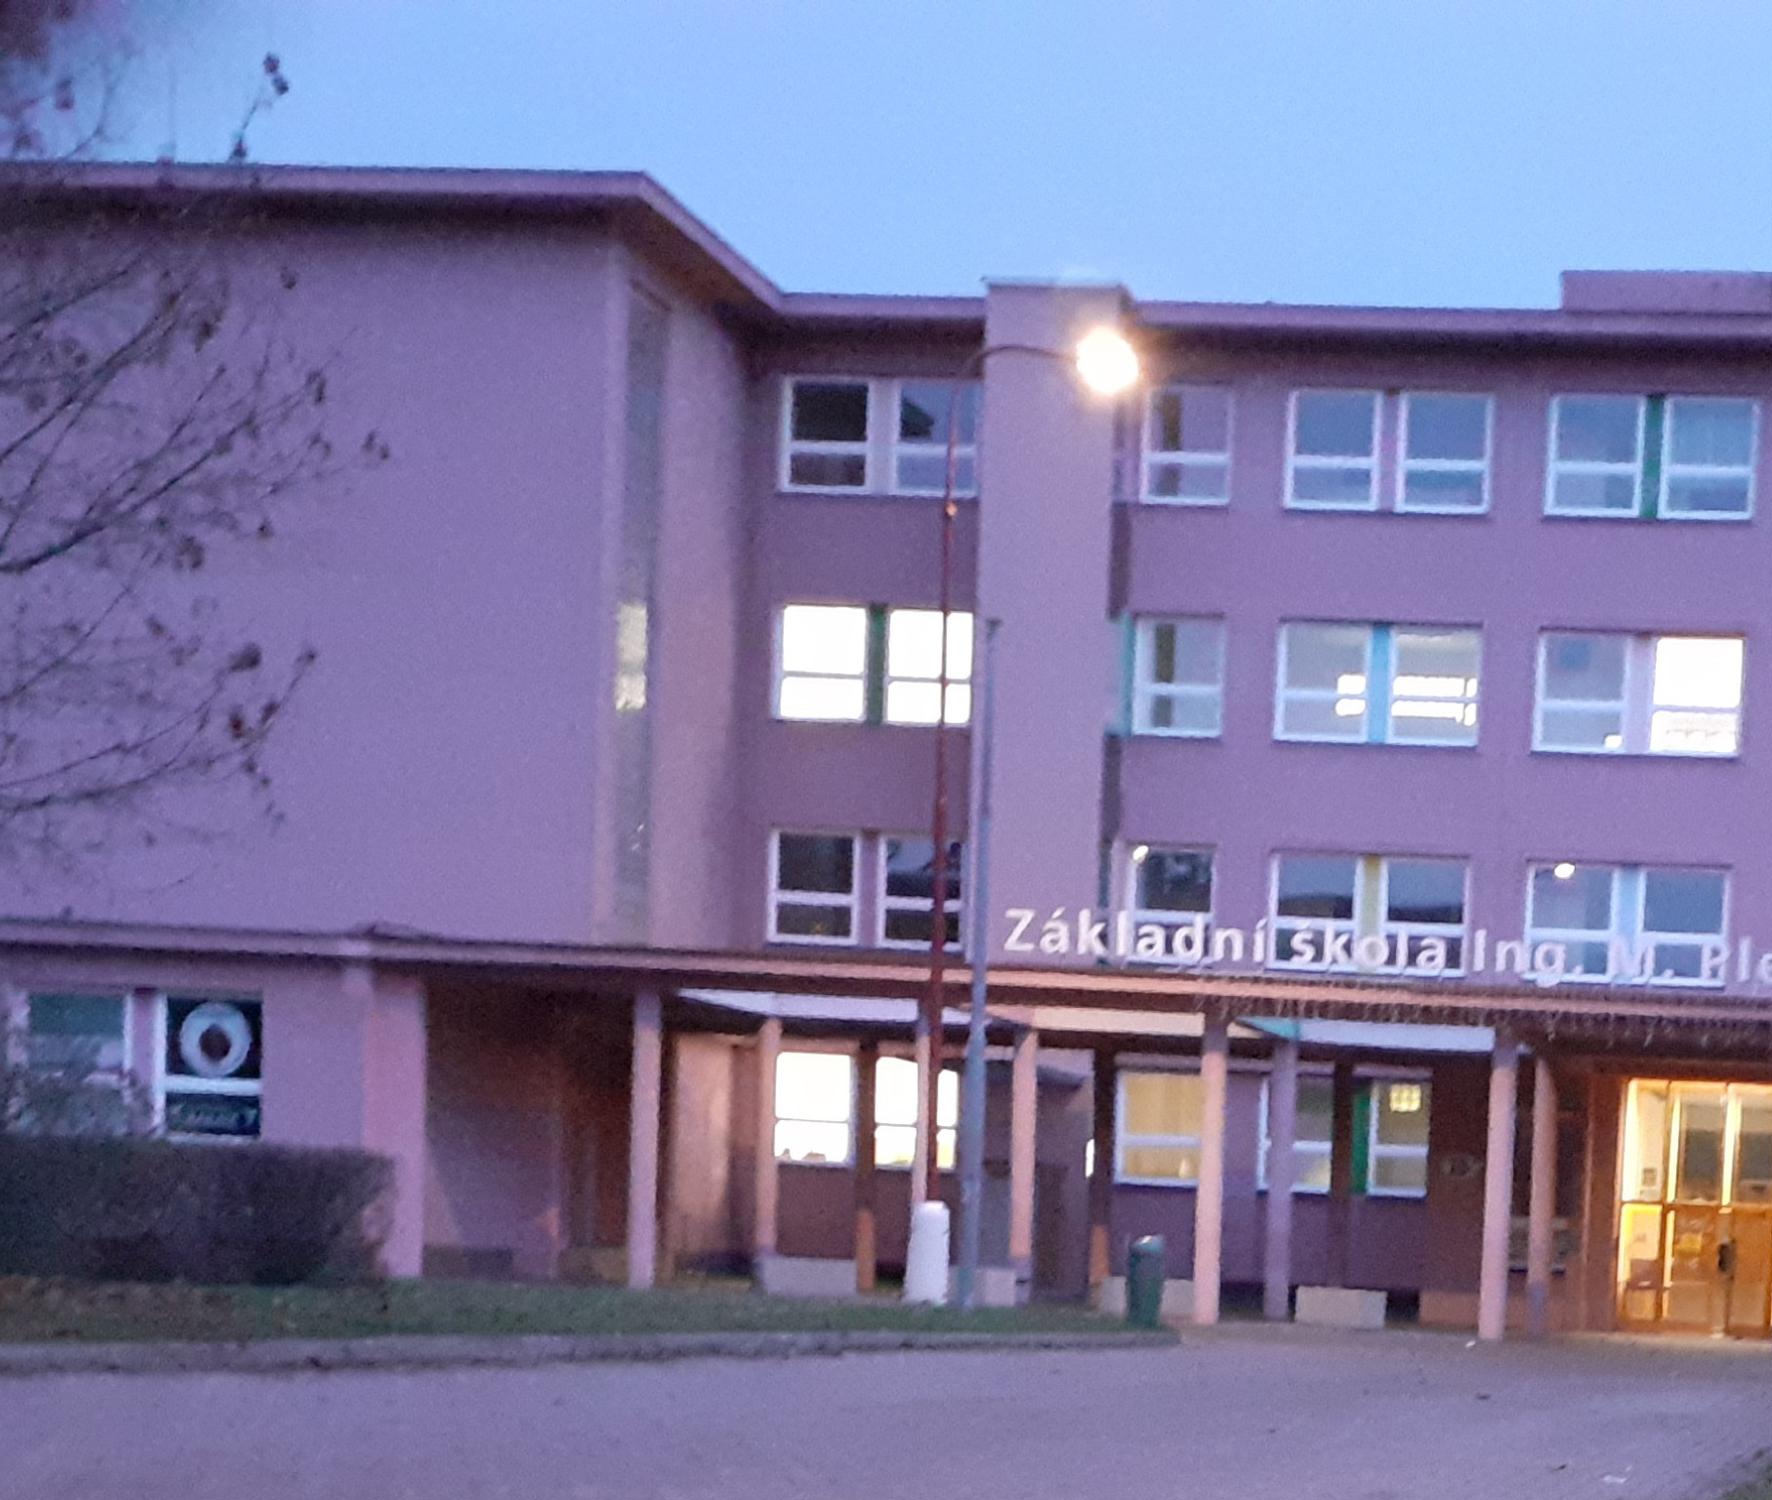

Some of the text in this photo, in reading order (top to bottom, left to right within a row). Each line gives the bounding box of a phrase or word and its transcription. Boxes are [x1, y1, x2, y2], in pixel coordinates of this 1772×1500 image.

[1004, 908, 1267, 962] Základní
[1291, 919, 1446, 970] škola
[1473, 929, 1582, 988] Ing.
